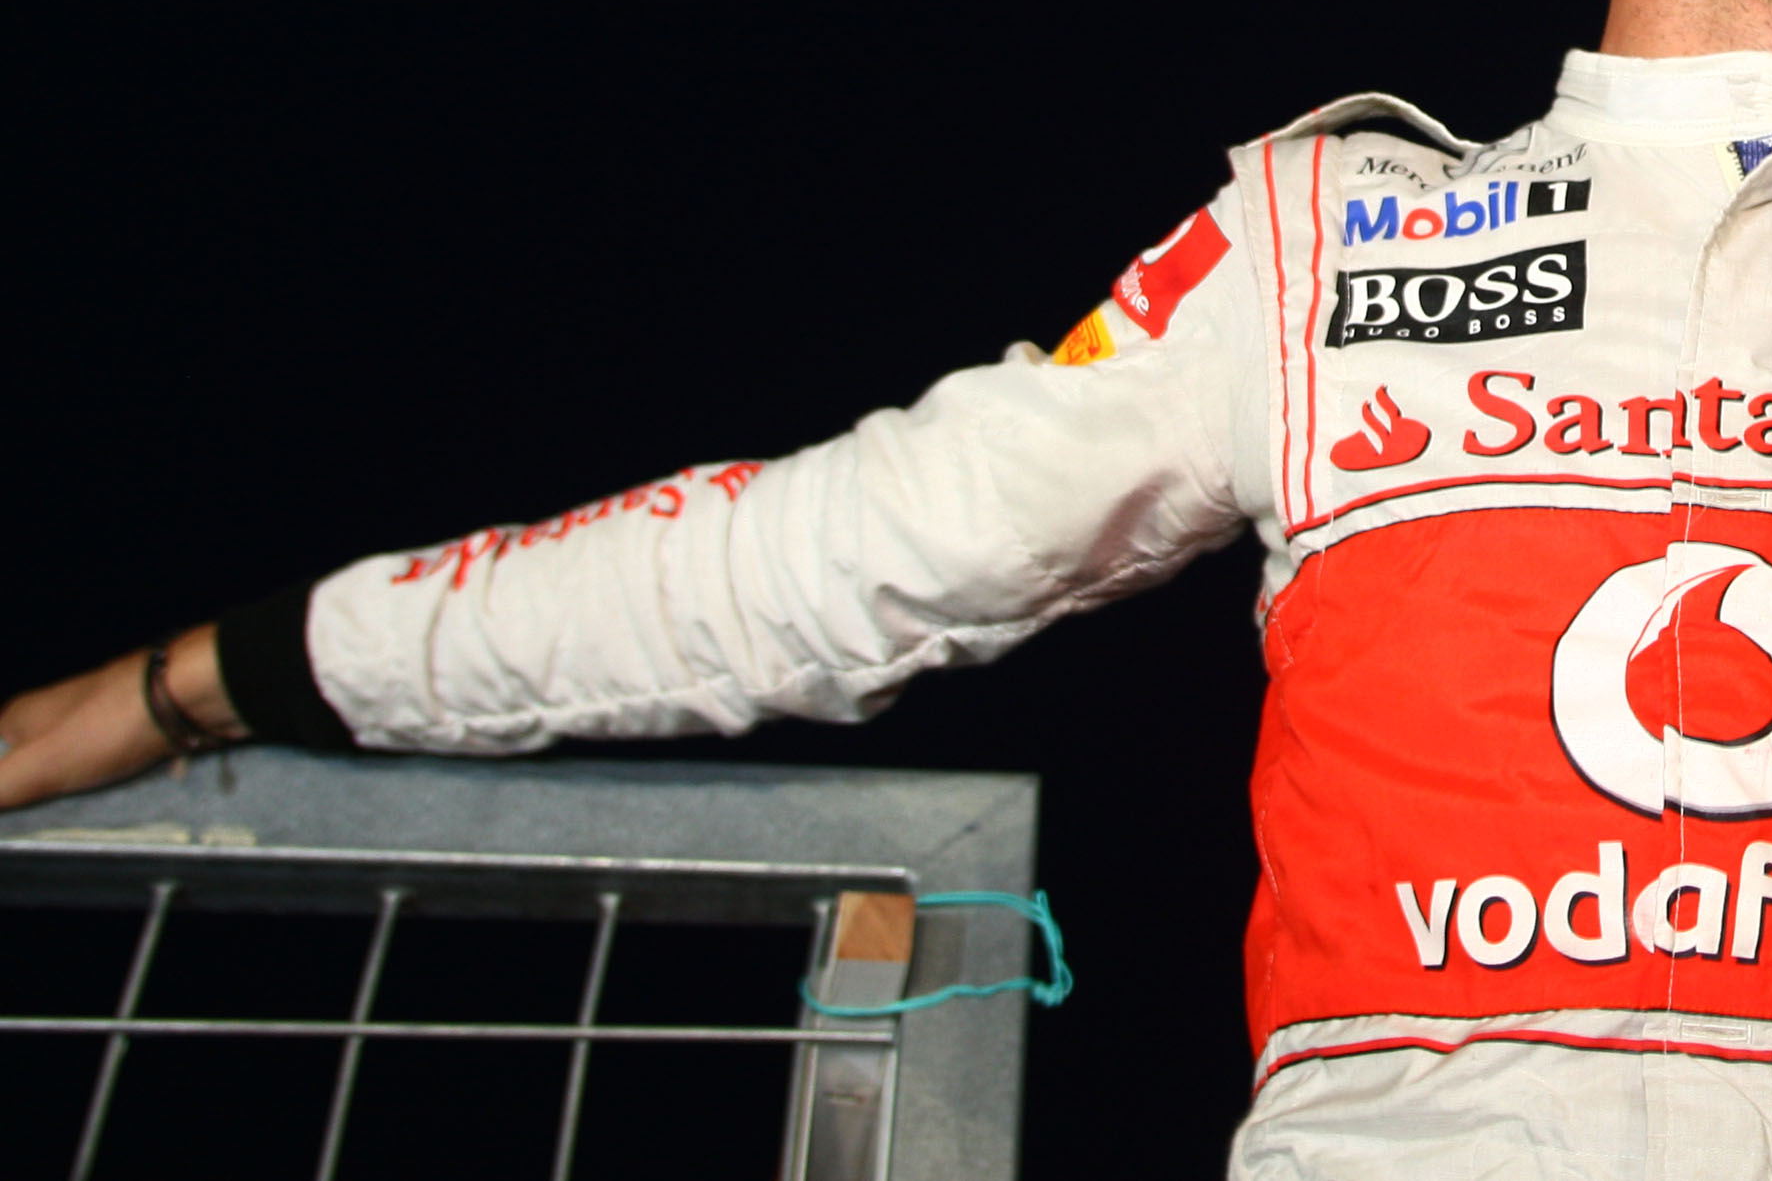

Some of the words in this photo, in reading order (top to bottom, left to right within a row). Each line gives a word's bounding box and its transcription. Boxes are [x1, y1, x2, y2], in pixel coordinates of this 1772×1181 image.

[1344, 181, 1519, 246] Mobil
[1347, 253, 1573, 326] BOSS
[1343, 326, 1440, 339] HUGO
[1468, 306, 1566, 336] BOSS
